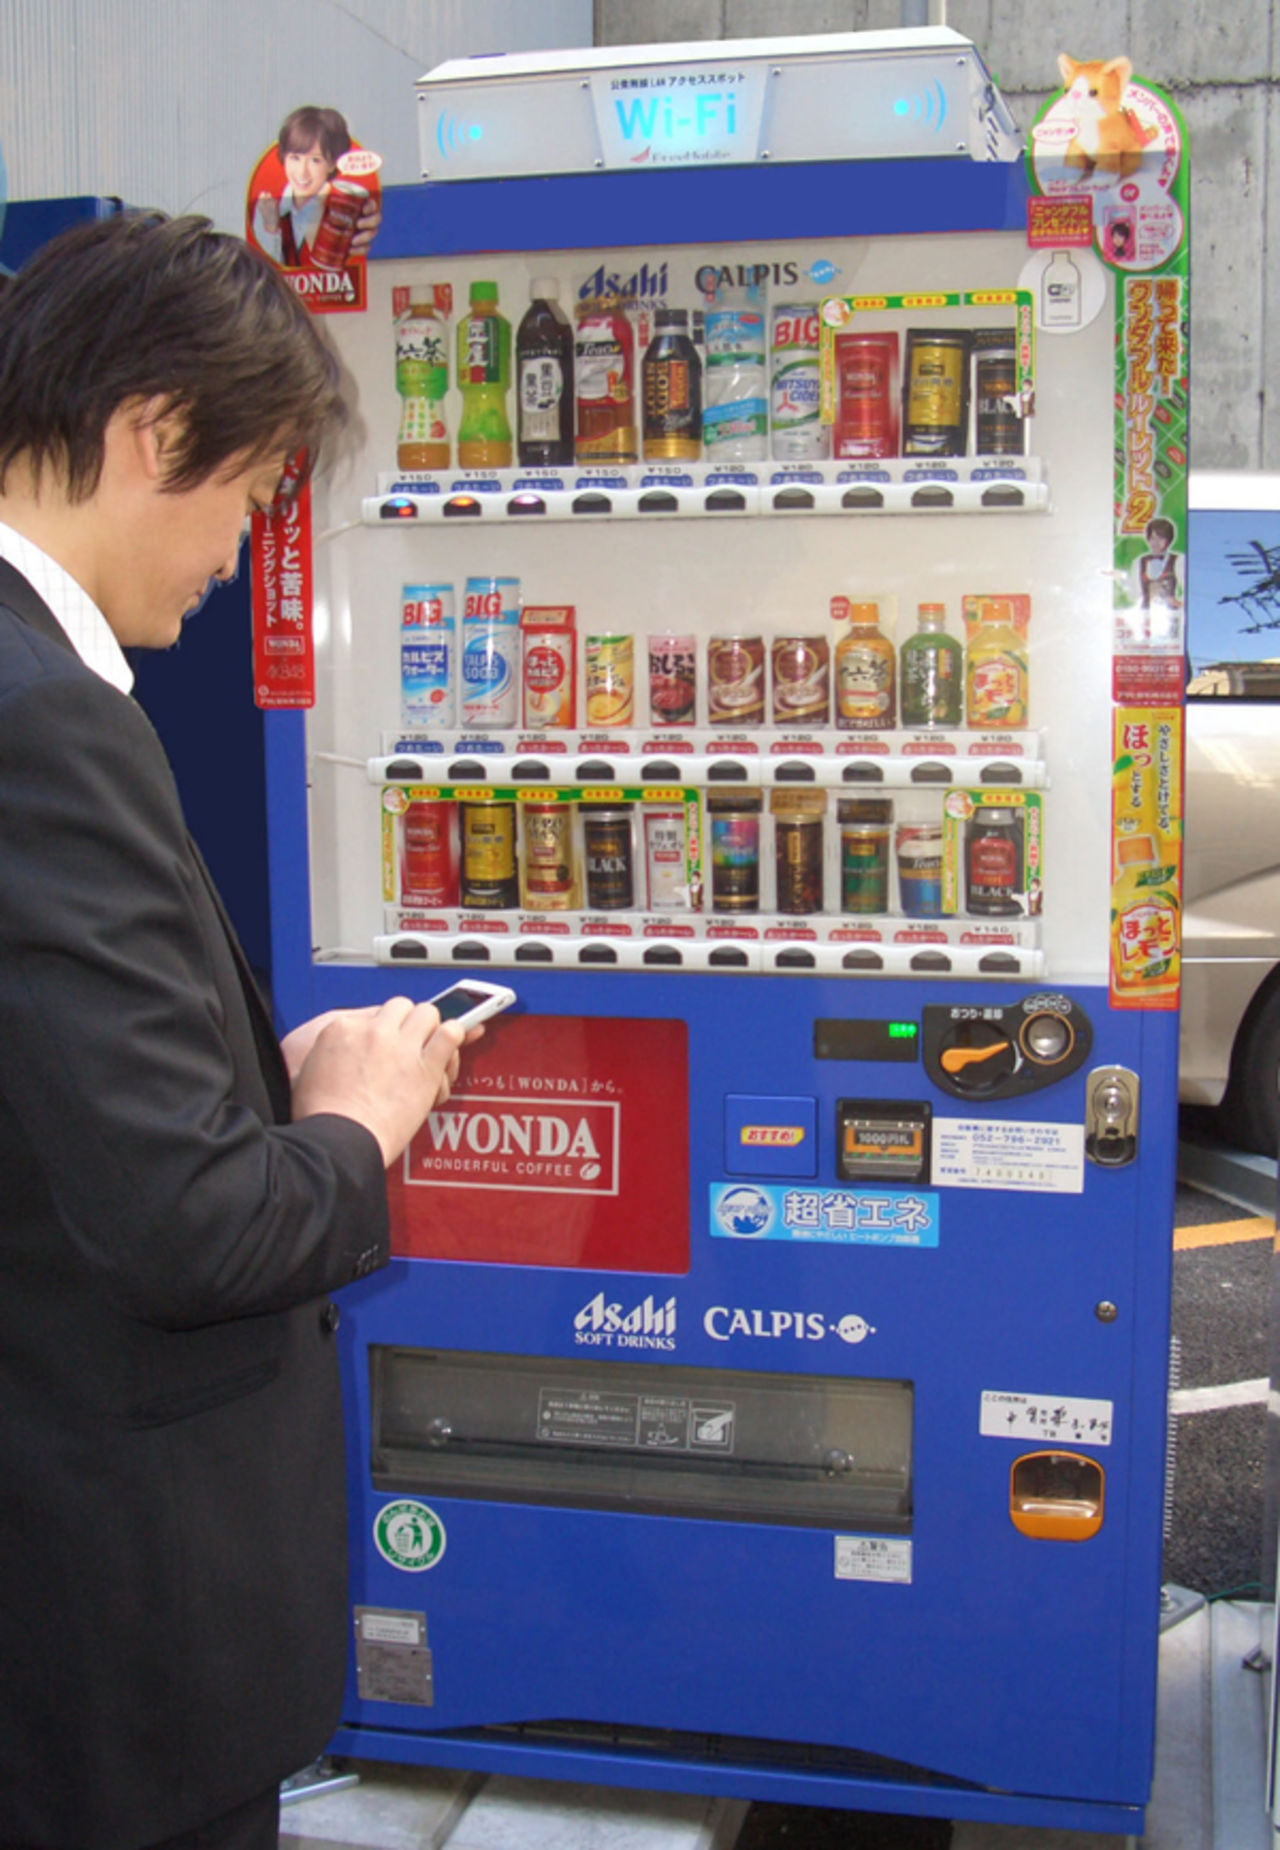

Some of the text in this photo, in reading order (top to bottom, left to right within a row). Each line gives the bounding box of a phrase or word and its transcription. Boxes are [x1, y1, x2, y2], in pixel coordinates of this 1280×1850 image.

[615, 92, 736, 139] Wi-Fi
[579, 262, 668, 300] Asahi
[695, 262, 799, 294] CALPIS
[402, 599, 443, 626] BIG
[465, 591, 502, 618] BIG
[427, 1111, 601, 1158] WONDA
[422, 1157, 573, 1176] WONDERFUL COFFEE
[784, 1191, 930, 1232] 超省エネ
[573, 1292, 677, 1337] Asahi
[704, 1306, 826, 1341] CALPIS
[574, 1331, 676, 1351] SOFT DRINKS
